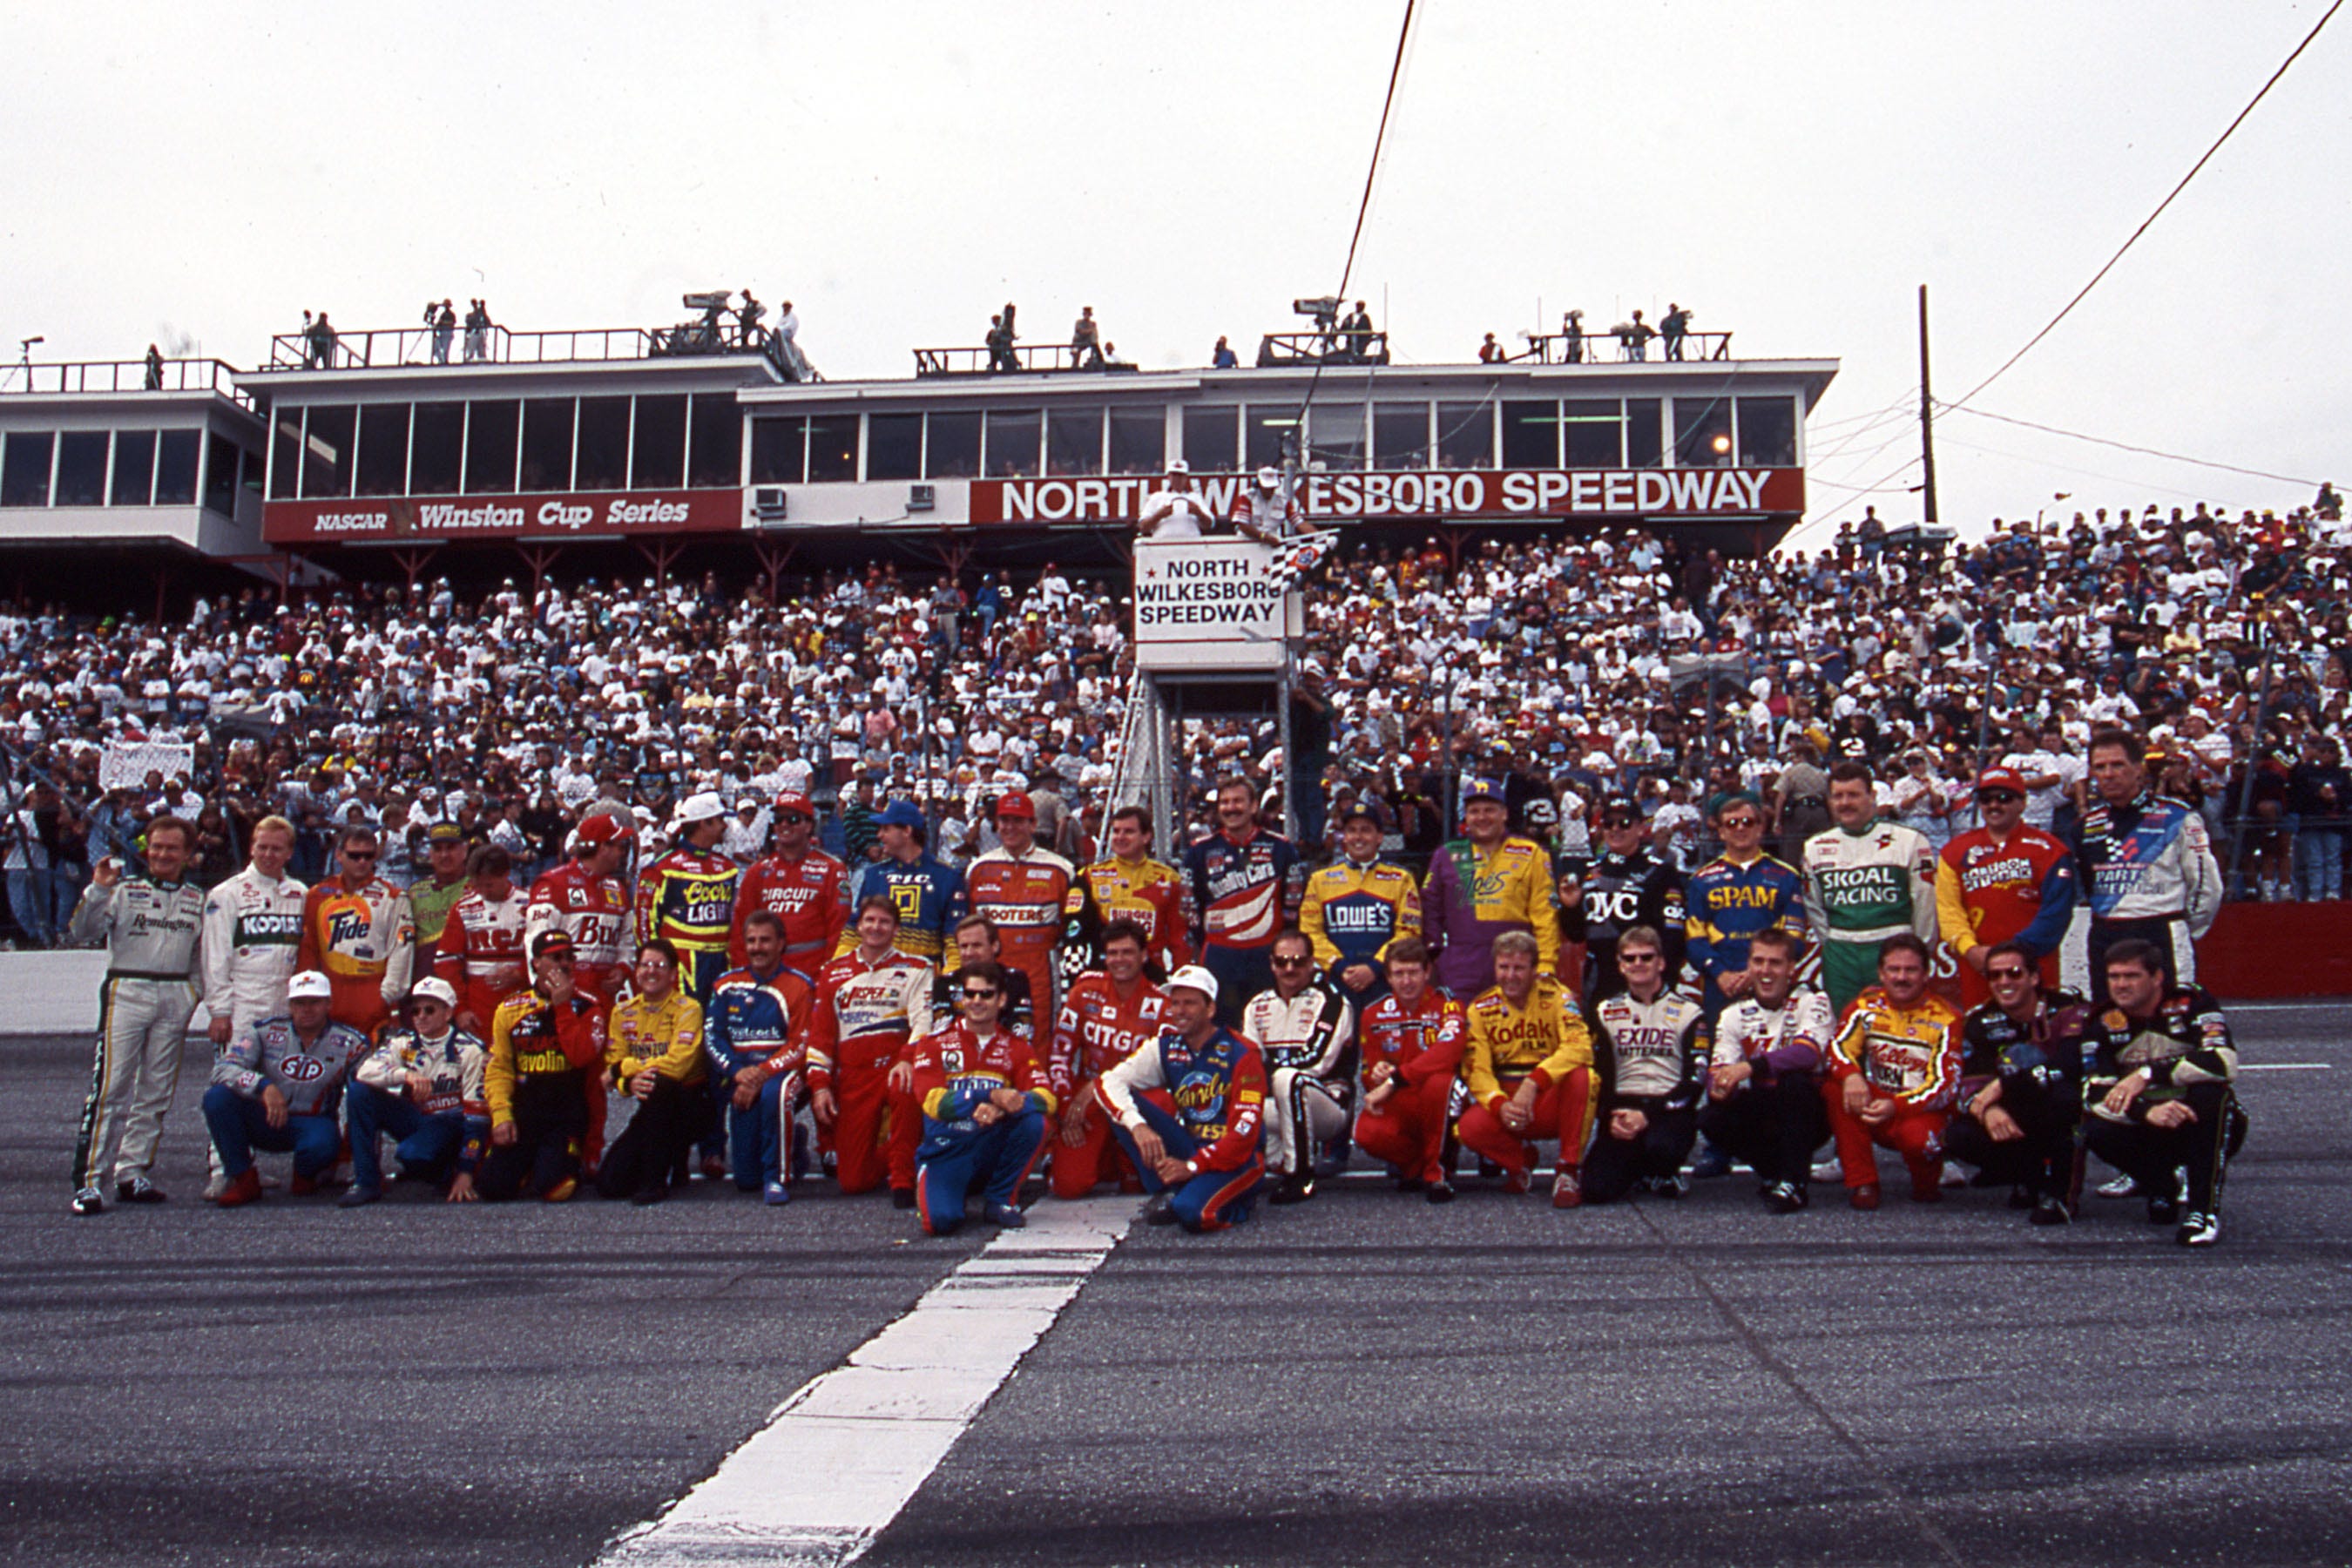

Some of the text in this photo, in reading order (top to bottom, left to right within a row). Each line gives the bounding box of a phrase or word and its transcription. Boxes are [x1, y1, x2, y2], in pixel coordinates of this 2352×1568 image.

[1190, 473, 1484, 516] WESBORO
[1502, 471, 1772, 512] SPEEDWAY
[315, 500, 688, 531] NASCAR Winston Cup Series
[1167, 559, 1249, 578] NORTH
[1139, 603, 1275, 625] SPEEDWAY
[1524, 798, 1558, 823] 3
[1824, 868, 1896, 889] SKOAL
[683, 882, 733, 905] Coors
[1707, 886, 1779, 910] SPAM
[531, 908, 551, 922] Bud
[767, 902, 805, 914] CITY
[1325, 902, 1390, 927] LOWE'S
[1585, 891, 1639, 924] QVC
[133, 914, 195, 933] Remington
[243, 916, 301, 935] KODIA
[328, 909, 370, 951] Tide
[576, 916, 621, 945] Bud
[1084, 1021, 1148, 1051] CITGO
[1485, 1020, 1552, 1045] Kodak
[1615, 1027, 1675, 1046] EXIDE
[283, 1058, 321, 1077] STP
[517, 1051, 567, 1073] avolin
